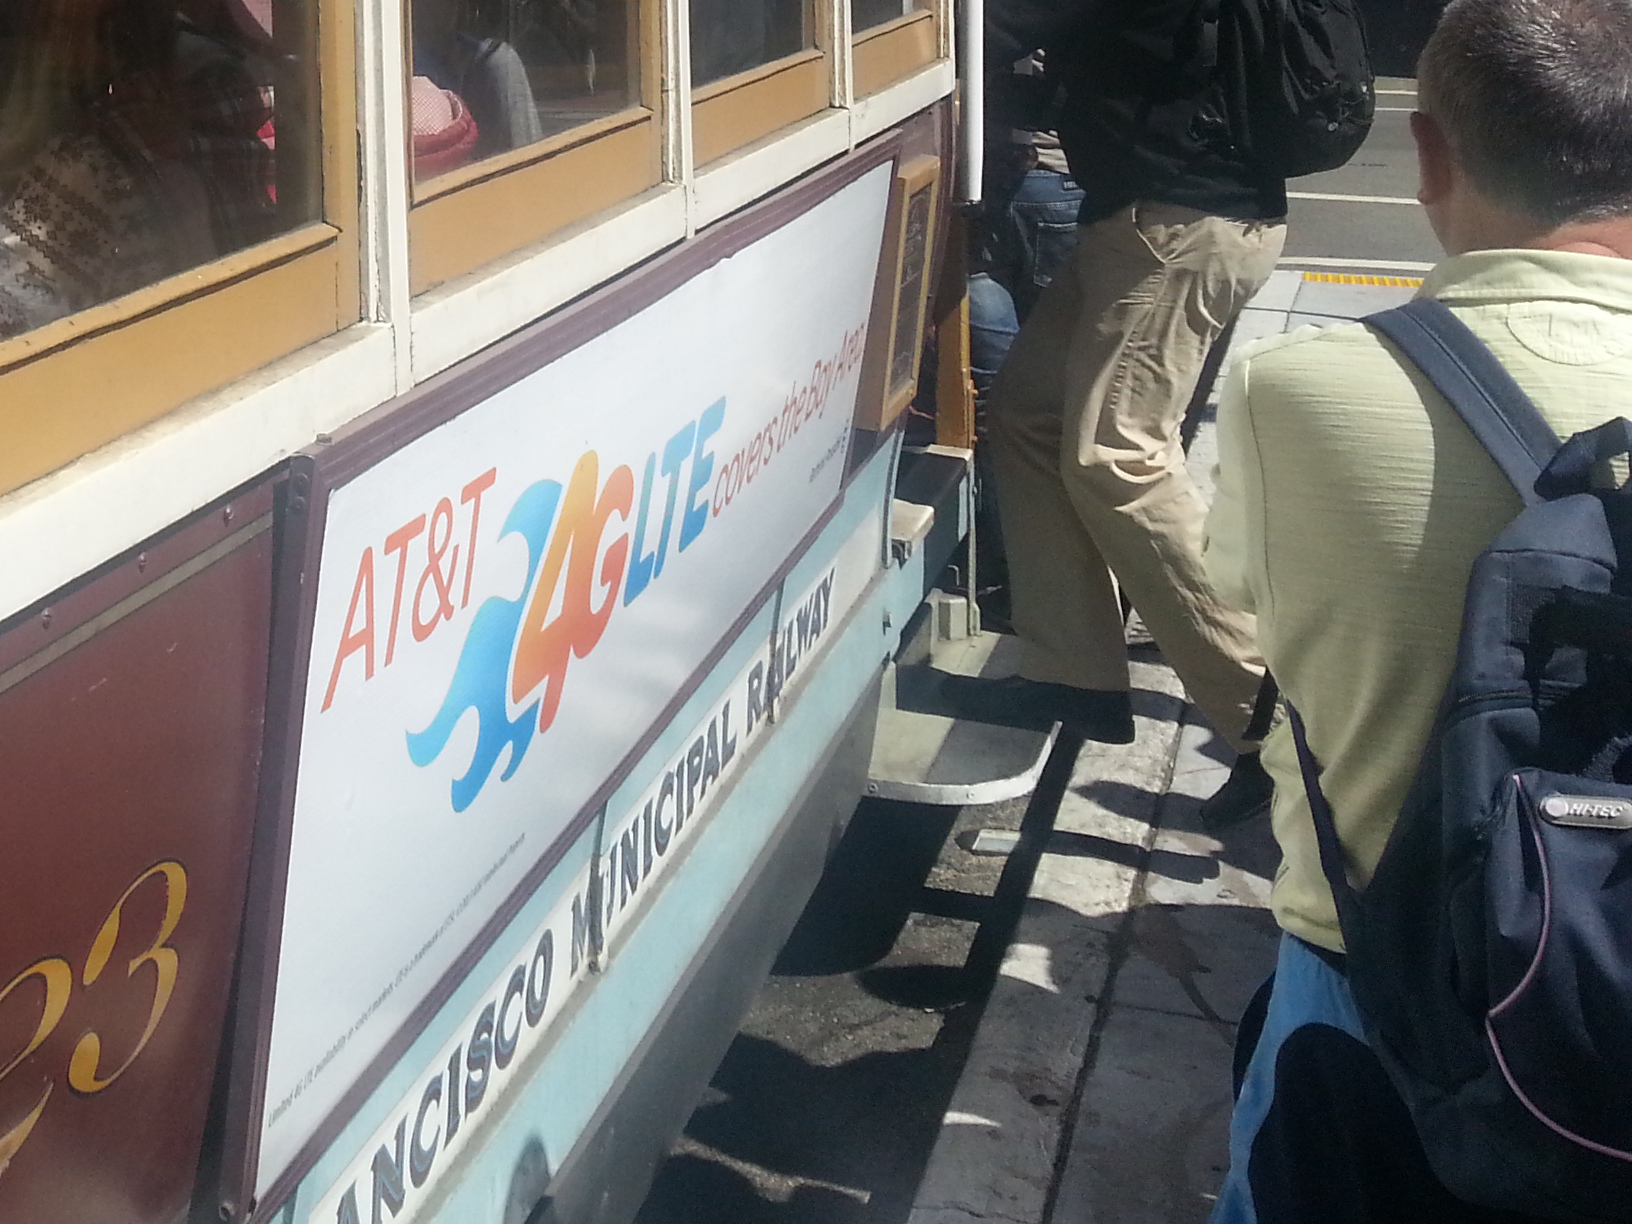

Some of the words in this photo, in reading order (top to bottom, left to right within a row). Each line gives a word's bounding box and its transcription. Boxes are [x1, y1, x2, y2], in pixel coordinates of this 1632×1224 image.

[321, 467, 497, 714] AT&T
[713, 416, 778, 517] covers
[776, 381, 807, 452] the
[746, 566, 836, 738] RAILWAY
[1569, 803, 1624, 817] HI-TEC
